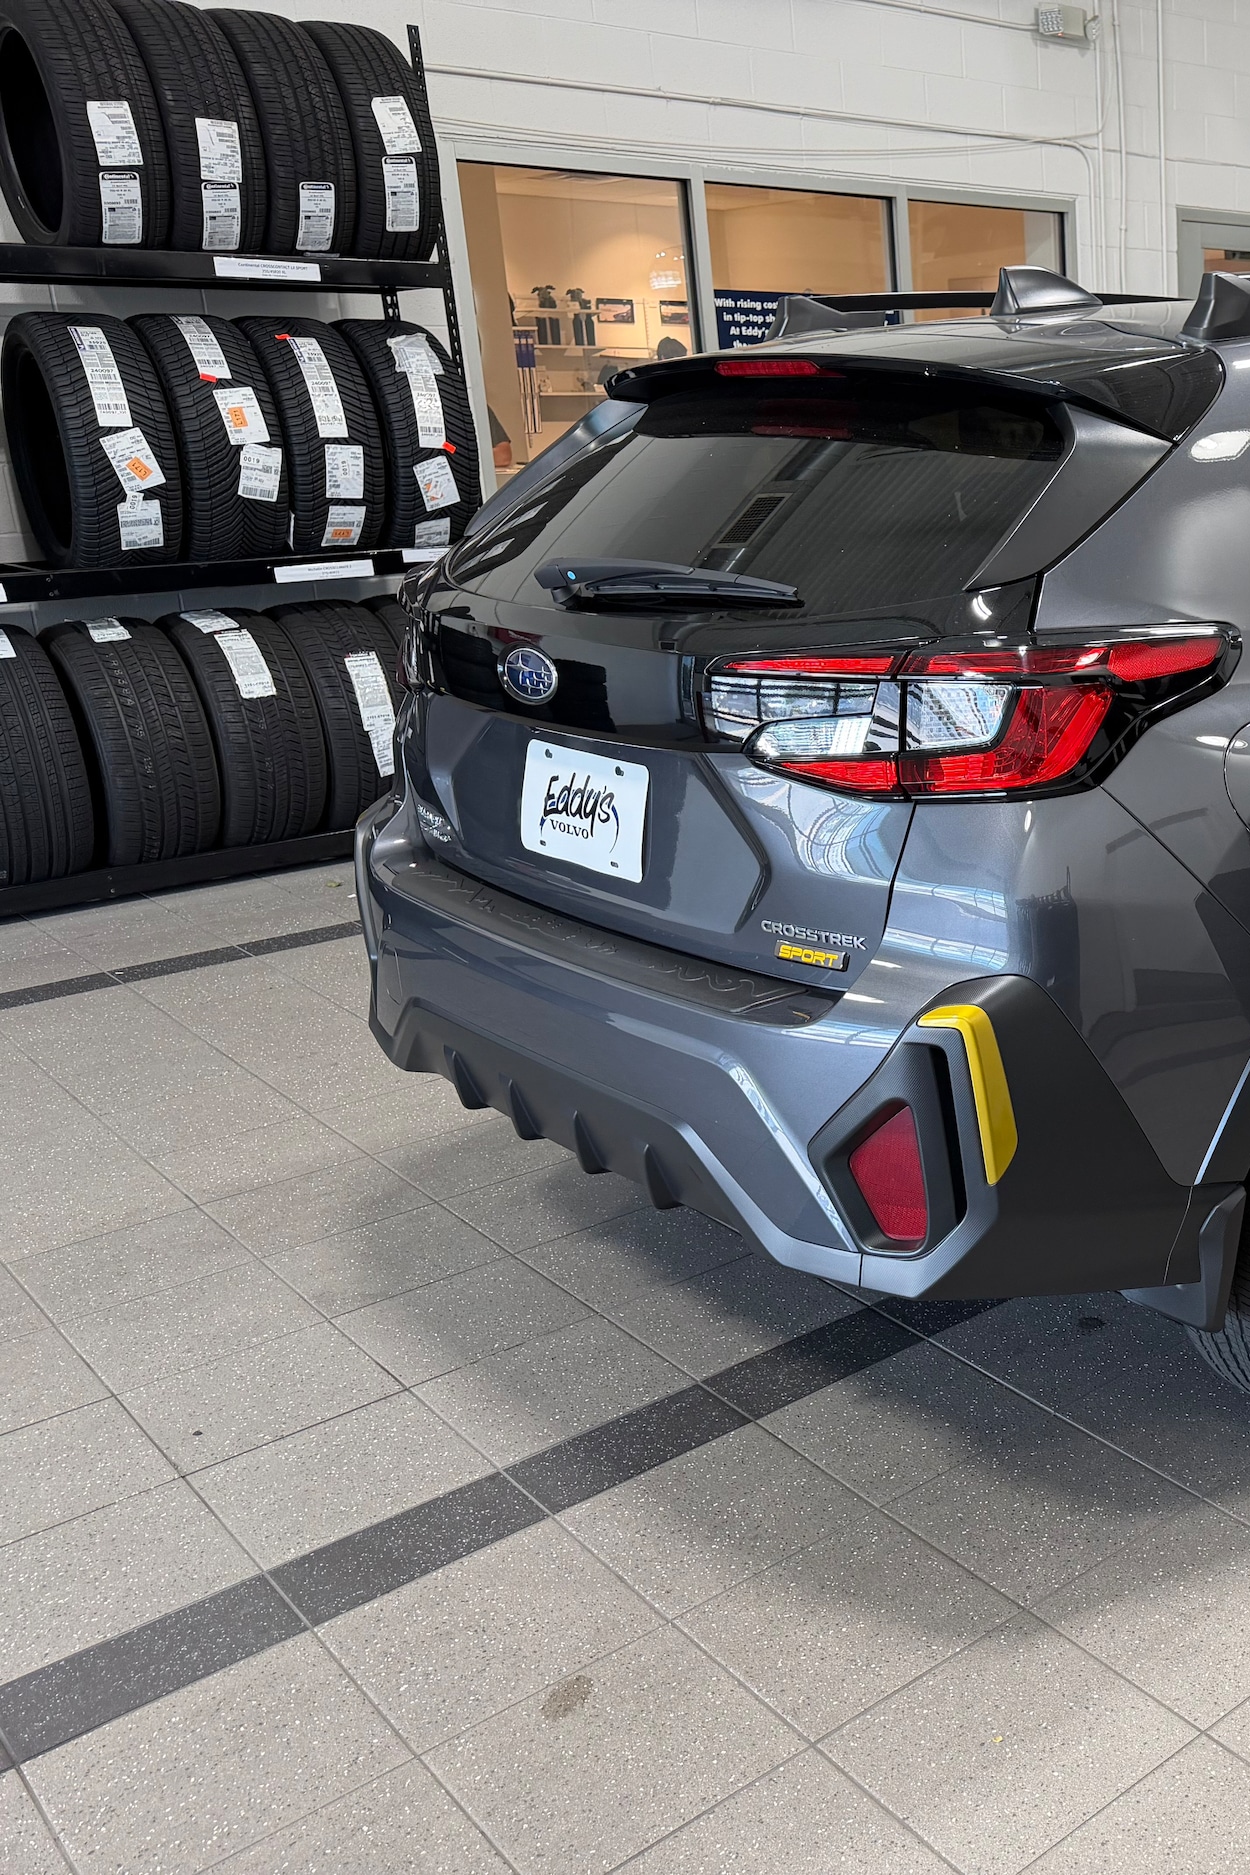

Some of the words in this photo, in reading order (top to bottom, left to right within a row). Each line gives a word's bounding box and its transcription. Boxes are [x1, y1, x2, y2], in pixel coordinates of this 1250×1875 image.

[714, 298, 735, 308] With
[736, 299, 762, 310] rising
[763, 301, 779, 309] cos
[723, 312, 733, 321] in
[734, 312, 764, 324] tip-top
[729, 326, 740, 335] At
[243, 455, 260, 463] 0019
[543, 772, 615, 838] Eddy's
[549, 818, 589, 840] VOLVO
[760, 919, 868, 951] CROSSTREK
[778, 944, 839, 968] SPORT
